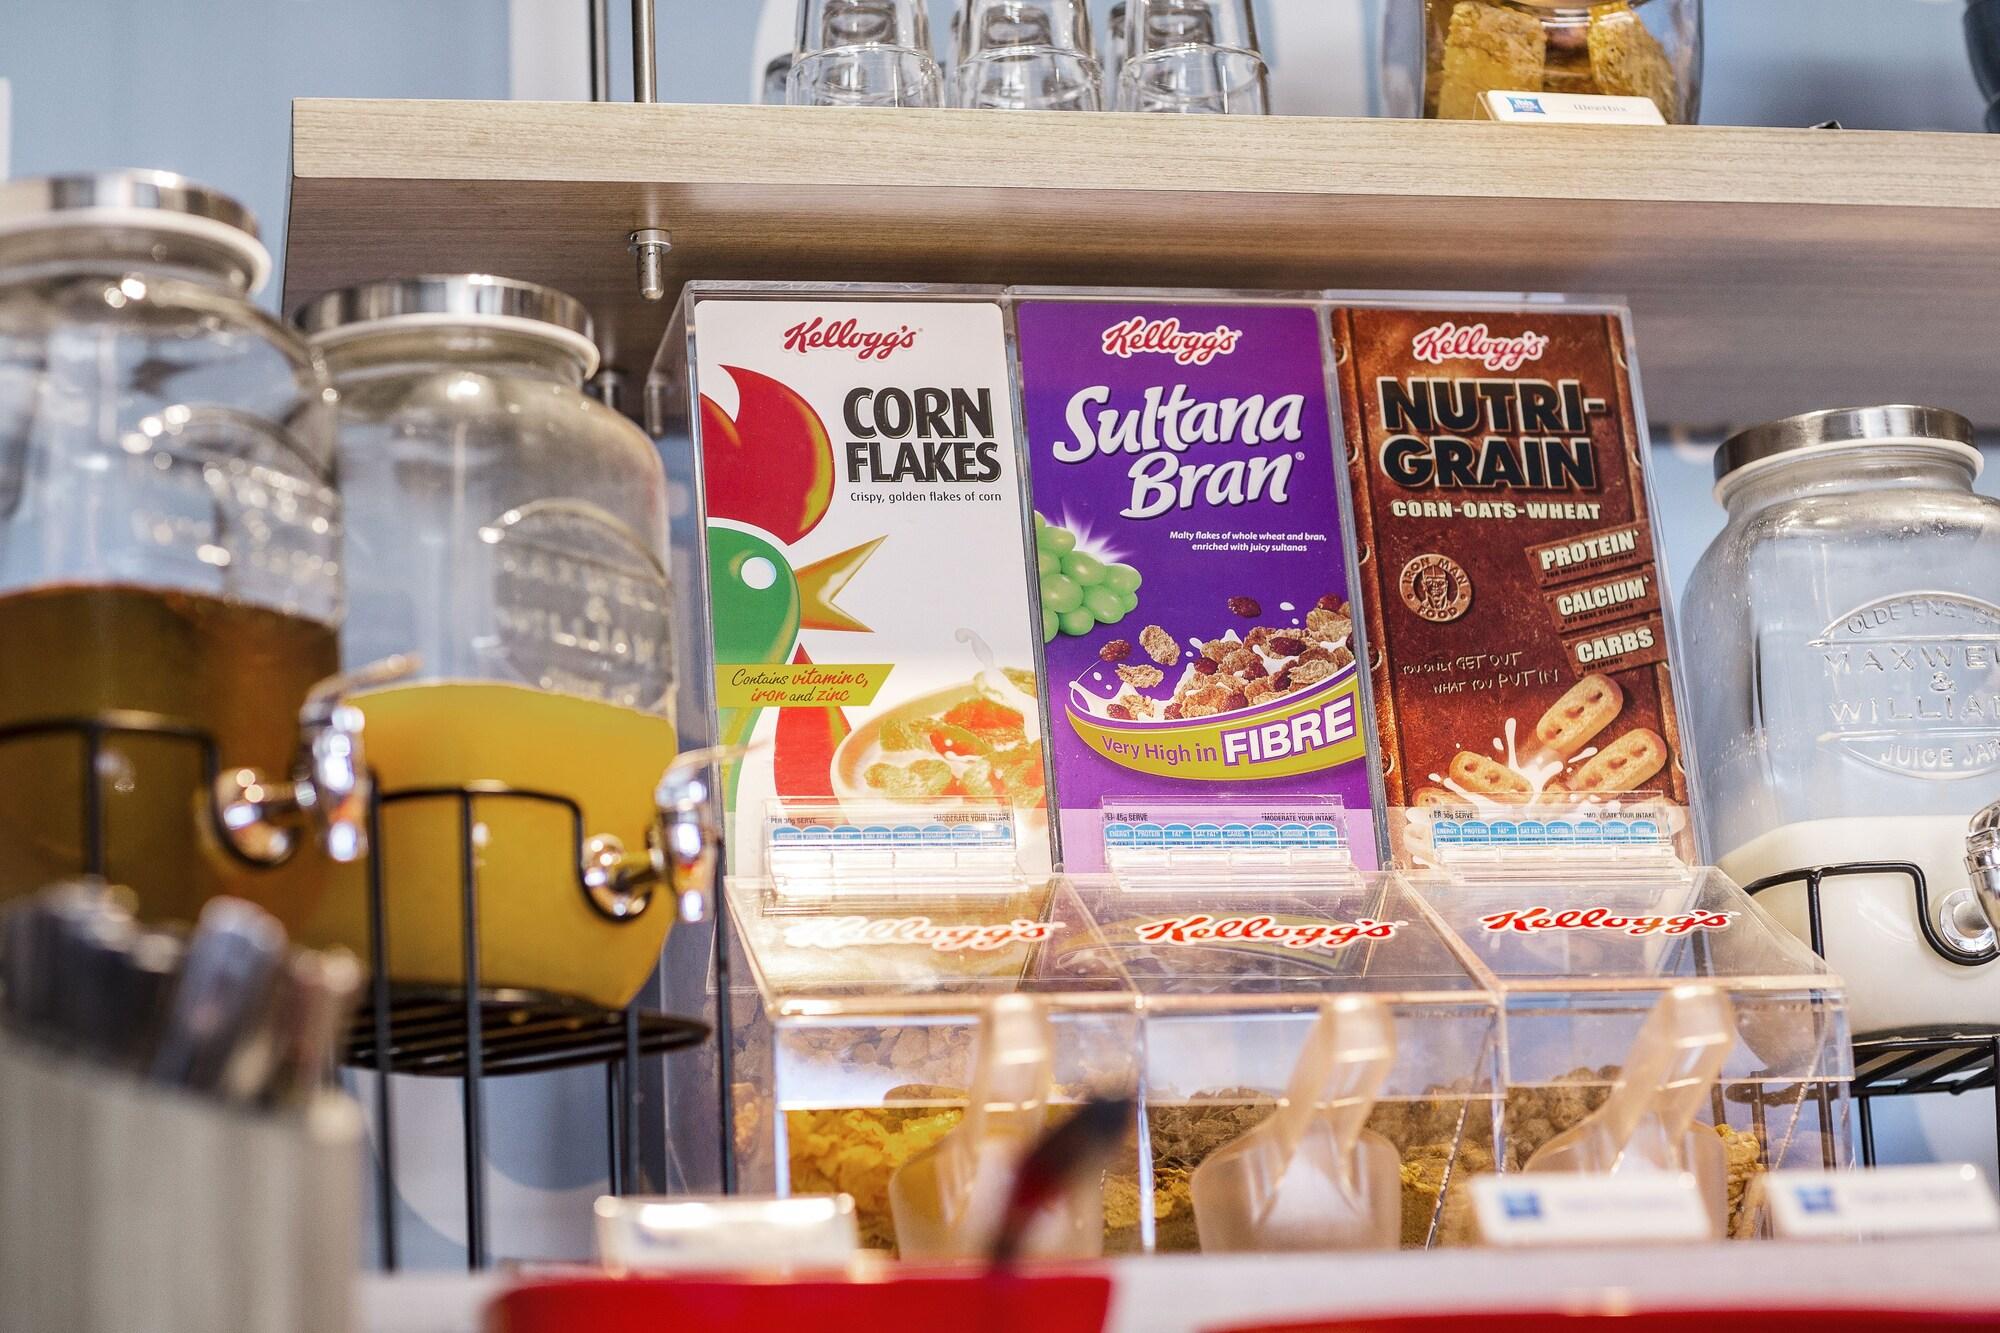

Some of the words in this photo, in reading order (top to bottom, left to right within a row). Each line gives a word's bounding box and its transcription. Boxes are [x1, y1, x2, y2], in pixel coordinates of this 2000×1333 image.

[784, 317, 916, 359] Kellogg's
[1104, 319, 1235, 362] Kellogg's
[1415, 325, 1542, 368] Kellogg's
[843, 387, 994, 439] CORN
[1377, 376, 1605, 433] NUTRI-
[1052, 384, 1304, 463] Sultana
[847, 442, 1002, 483] FLAKES
[1380, 435, 1597, 490] GRAIN
[850, 492, 885, 504] Crispy,
[888, 491, 926, 504] golden
[930, 491, 961, 502] flakes
[965, 491, 976, 502] of
[979, 493, 1002, 502] corn
[1119, 451, 1293, 519] Bran
[1169, 531, 1194, 541] Malty
[1196, 531, 1220, 540] flakes
[1222, 531, 1231, 540] of
[1232, 531, 1257, 540] whole
[1259, 532, 1285, 541] wheat
[1286, 532, 1303, 541] and
[1305, 532, 1327, 542] bran,
[1192, 543, 1228, 551] enriched
[1230, 543, 1248, 551] with
[1249, 543, 1270, 553] juicy
[1272, 543, 1307, 552] sultanas
[1402, 557, 1430, 584] IRON
[1438, 558, 1468, 585] MAN
[1417, 605, 1457, 618] FOOD
[1848, 603, 1901, 633] OLDE
[1575, 626, 1655, 663] CARBS
[731, 668, 789, 686] Contains
[792, 667, 853, 685] vitamin
[855, 672, 869, 688] c,
[1402, 665, 1421, 675] YOU
[1424, 661, 1452, 673] ONLY
[1456, 654, 1487, 670] GET
[1489, 652, 1523, 667] OUT
[751, 687, 787, 702] iron
[789, 686, 817, 702] and
[816, 687, 849, 702] zinc
[1433, 682, 1466, 694] WHAT
[1471, 679, 1492, 691] YOU
[1498, 670, 1536, 689] PUT
[1538, 668, 1559, 684] IN
[1930, 671, 1956, 692] &
[1102, 735, 1140, 760] Very
[1144, 743, 1192, 766] High
[1195, 743, 1217, 761] in
[1223, 696, 1355, 765] FIBRE
[1881, 746, 1953, 767] JUICE
[1128, 813, 1148, 821] SERVE
[1298, 813, 1313, 821] YOUR
[1454, 810, 1474, 819] SERVE
[785, 917, 1051, 950] llogg's
[1141, 917, 1392, 946] Kellogg's
[1483, 907, 1729, 935] Kellogg's
